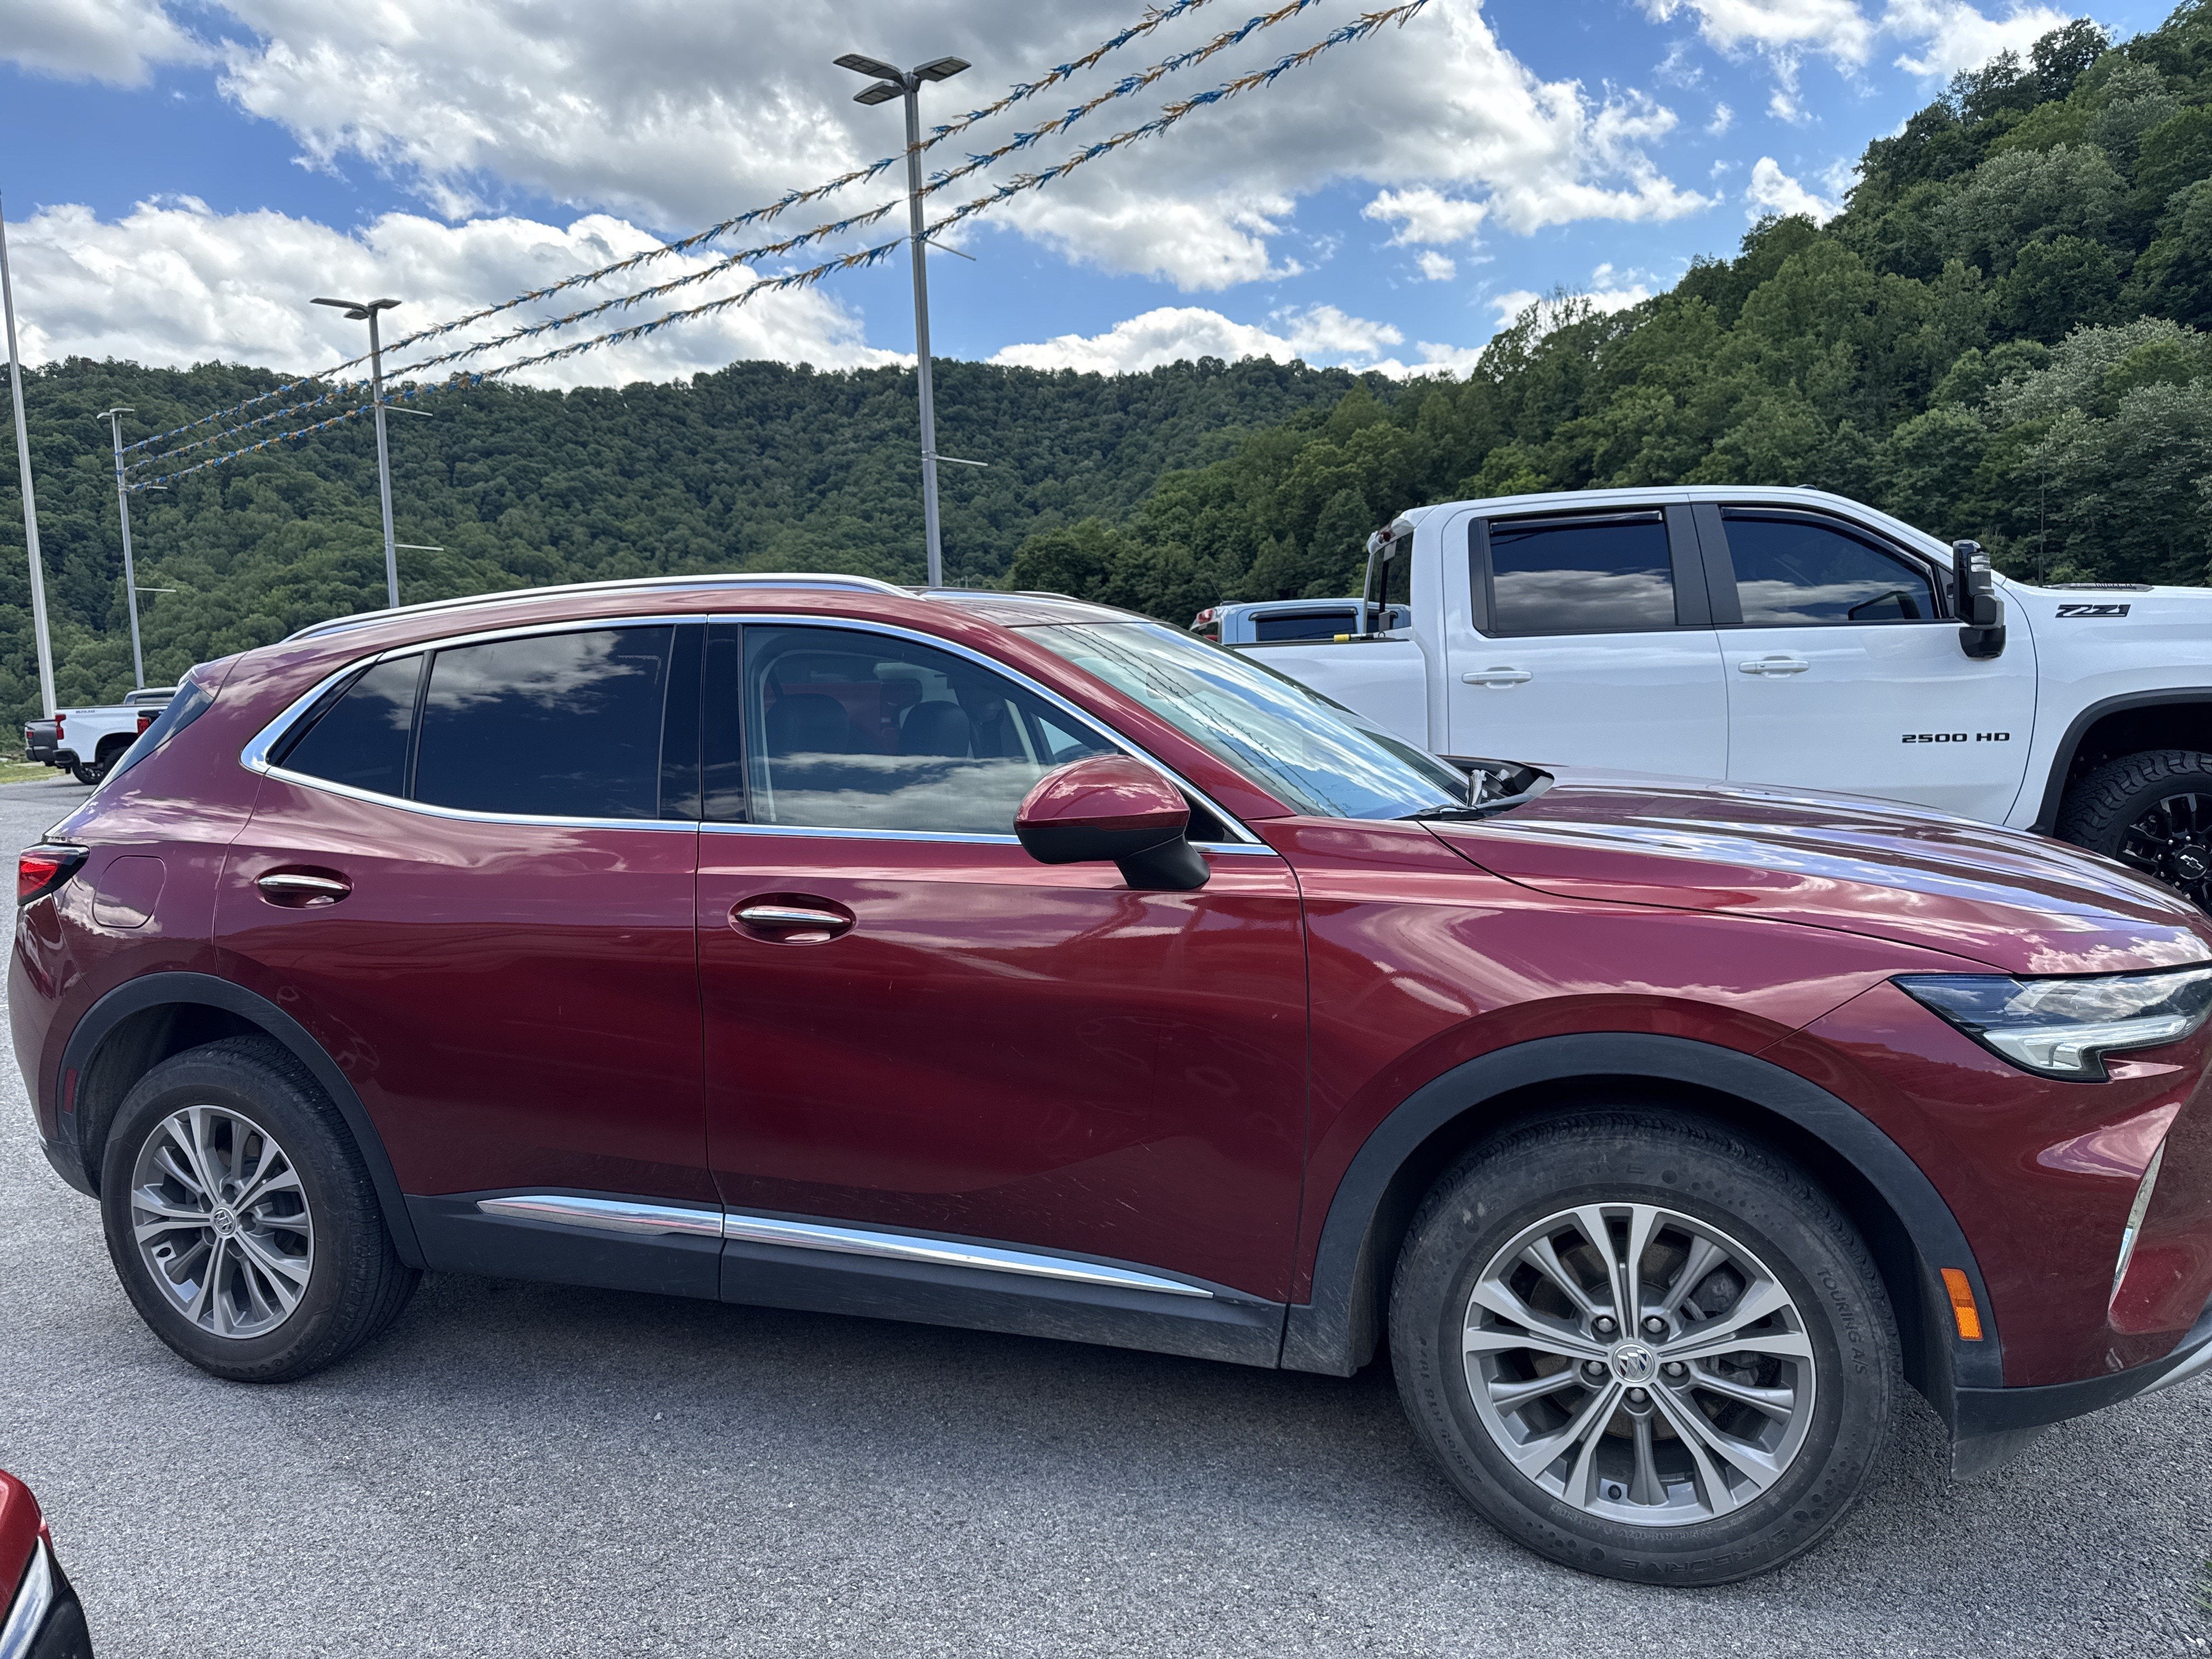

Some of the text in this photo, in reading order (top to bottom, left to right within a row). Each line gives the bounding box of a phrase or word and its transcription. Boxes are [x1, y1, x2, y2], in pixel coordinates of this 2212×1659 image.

[2055, 604, 2131, 619] Z71
[1901, 732, 2010, 743] 2500 HD
[1816, 1269, 1869, 1375] TOURING A/S
[1620, 1527, 1790, 1574] SUREDRIVE
